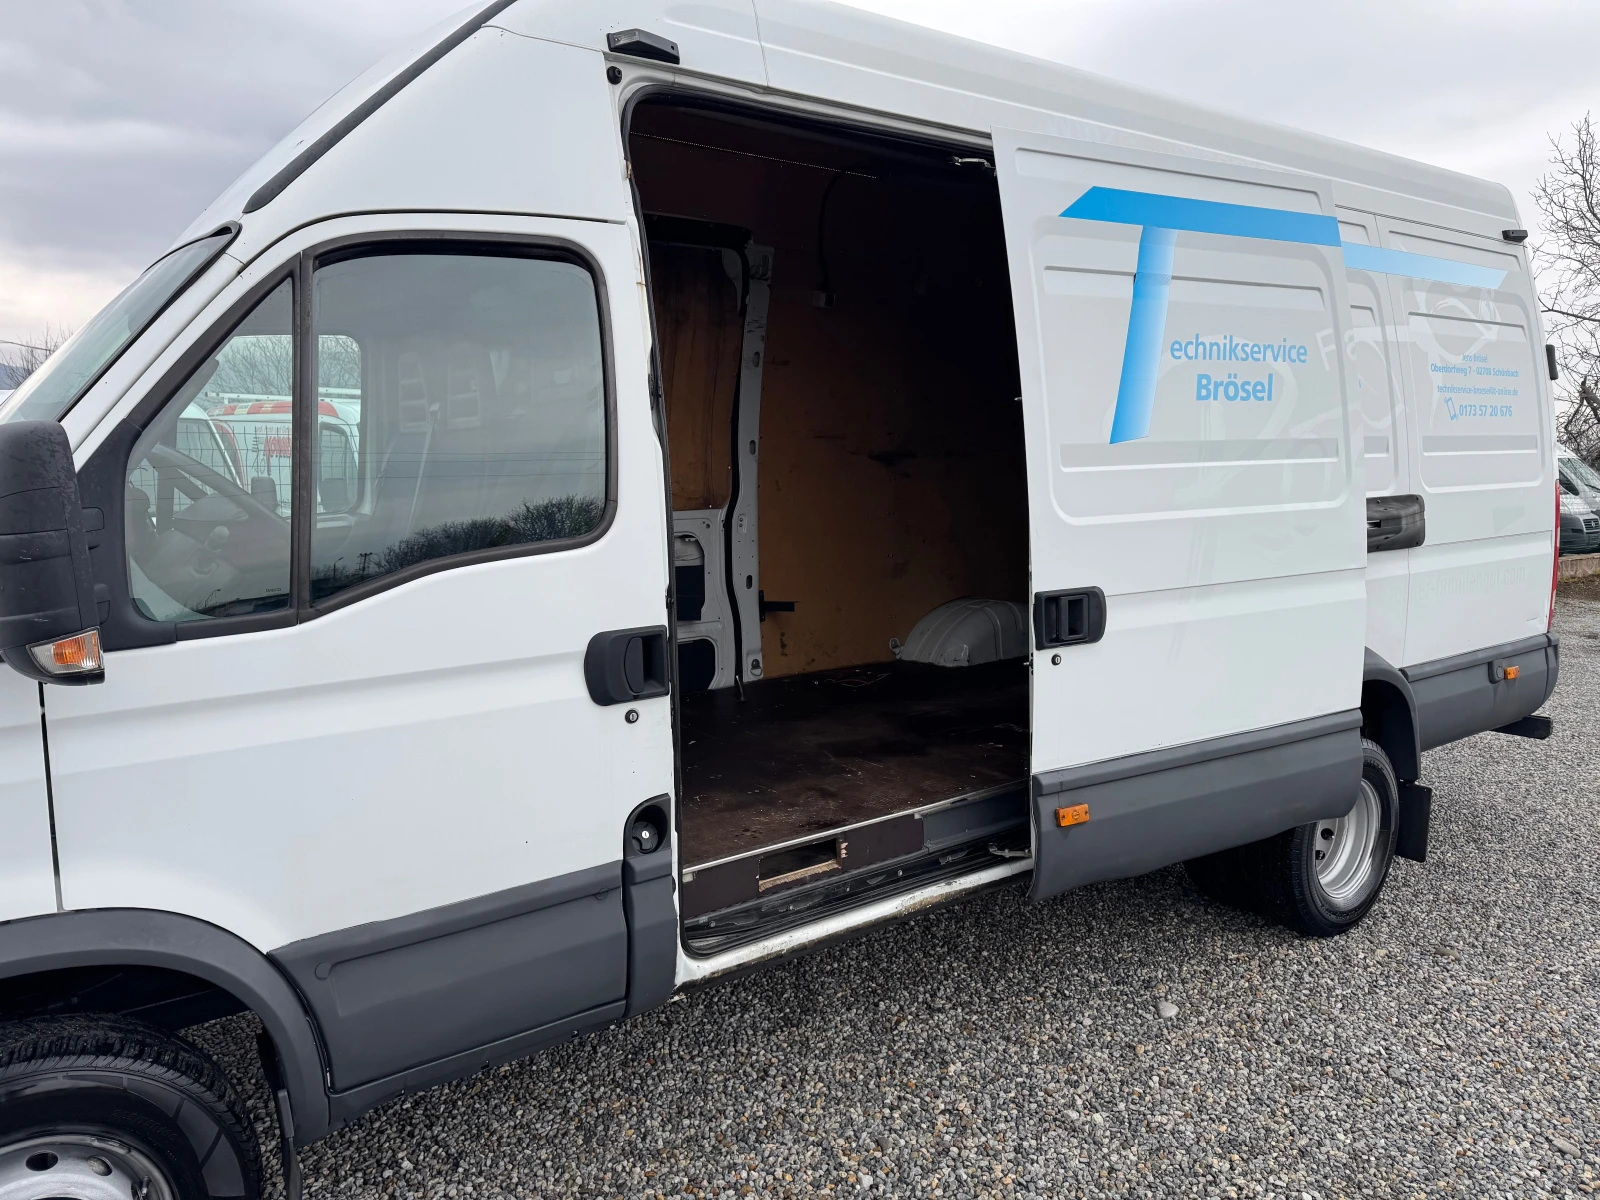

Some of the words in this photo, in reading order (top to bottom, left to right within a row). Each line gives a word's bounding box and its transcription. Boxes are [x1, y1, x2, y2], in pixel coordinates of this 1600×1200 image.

[1431, 364, 1467, 376] Oberdorfweg
[1492, 368, 1519, 378] Schönbach
[1195, 373, 1274, 402] Brösel
[1459, 404, 1477, 417] 0173
[1479, 405, 1488, 417] 57
[1490, 405, 1499, 417] 20
[1500, 405, 1513, 417] 676
